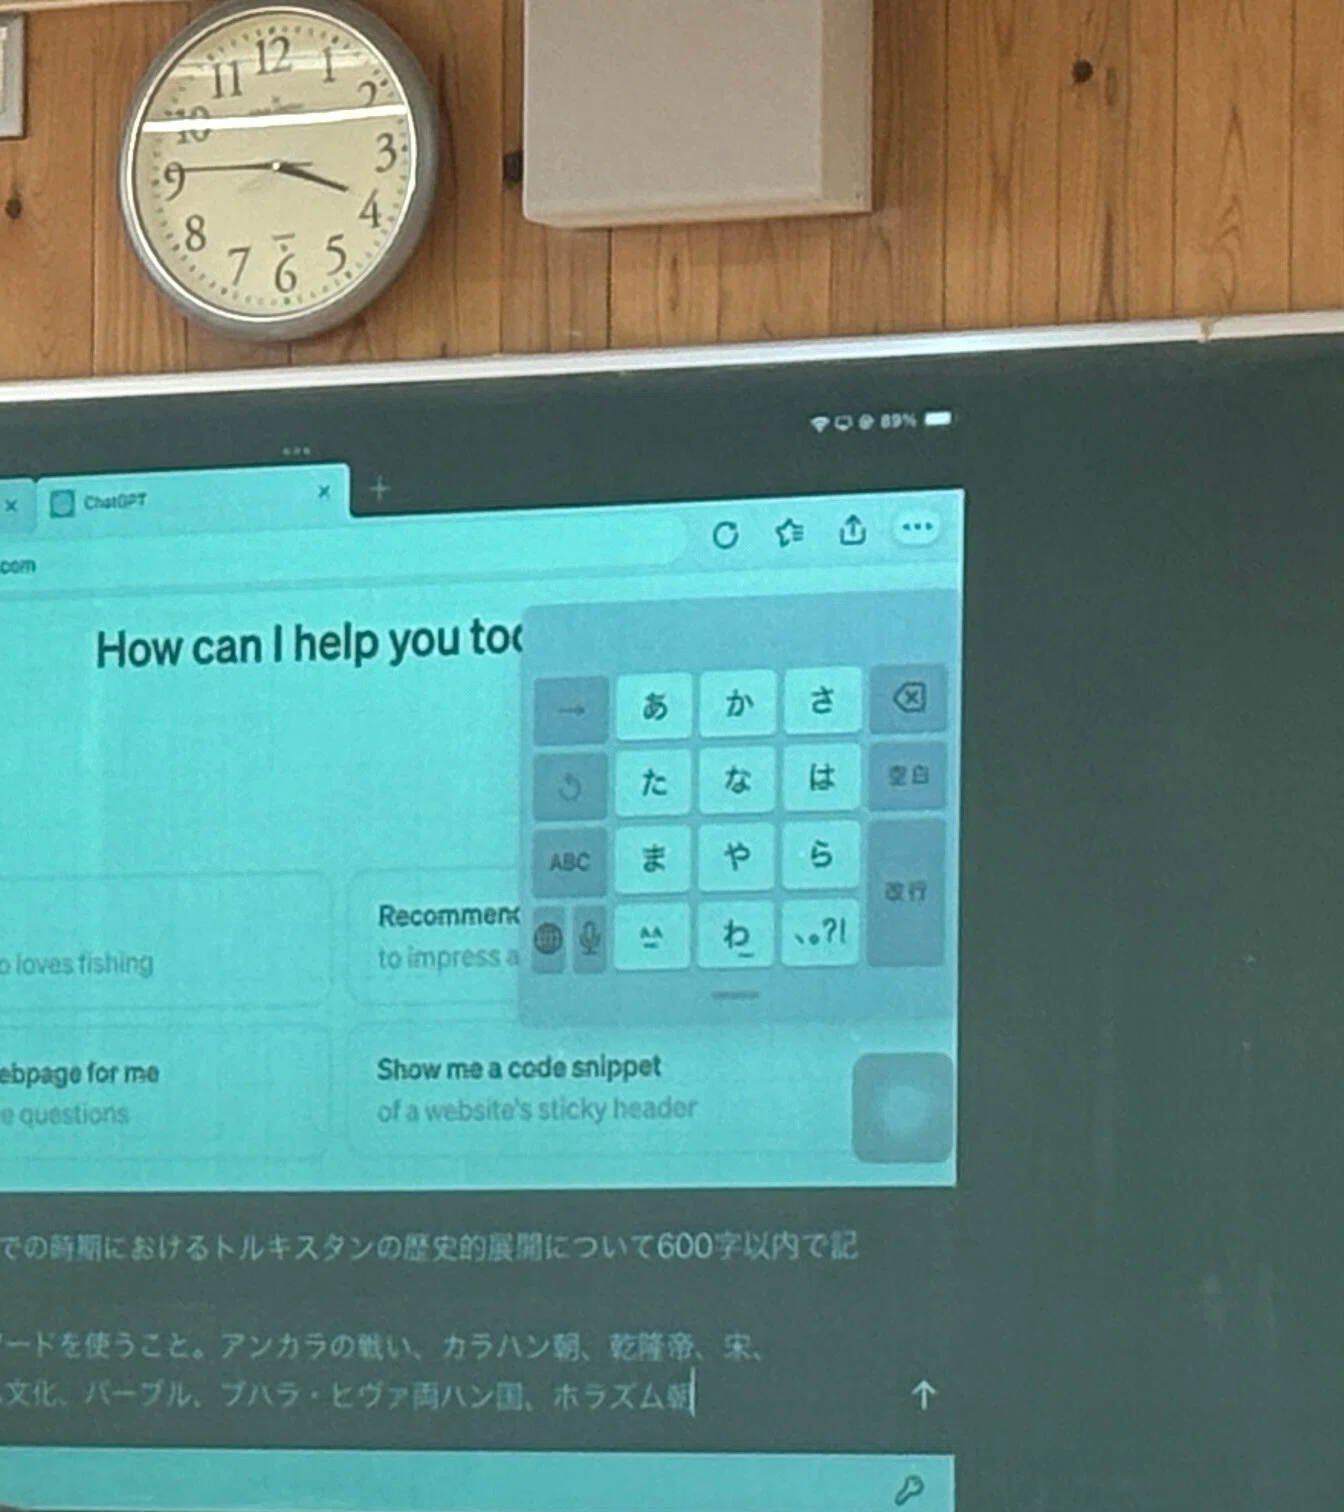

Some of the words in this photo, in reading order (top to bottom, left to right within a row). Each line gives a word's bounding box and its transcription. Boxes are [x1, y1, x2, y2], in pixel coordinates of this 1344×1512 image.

[255, 35, 293, 76] 12
[322, 46, 335, 83] 1
[212, 60, 243, 99] 11
[357, 80, 378, 107] 2
[176, 105, 211, 145] 10
[375, 132, 397, 173] 3
[164, 161, 186, 201] 9
[358, 188, 381, 229] 4
[185, 214, 206, 252] 8
[228, 247, 252, 286] 7
[274, 253, 297, 293] 6
[326, 233, 347, 276] 5
[880, 413, 917, 430] 89%
[84, 492, 147, 510] ChatGPT
[96, 629, 185, 668] How
[192, 632, 262, 665] can
[272, 623, 283, 663] I
[294, 621, 380, 668] help
[389, 624, 461, 667] you
[643, 691, 669, 721] あ
[725, 687, 754, 718] か
[810, 684, 836, 714] さ
[641, 767, 668, 797] た
[724, 764, 752, 793] な
[809, 762, 836, 791] は
[549, 851, 591, 873] ABC
[643, 844, 666, 873] ま
[724, 841, 752, 870] や
[810, 839, 833, 869] ら
[16, 951, 74, 976] loves
[78, 949, 154, 980] fishing
[379, 949, 402, 969] to
[407, 946, 501, 974] impress
[86, 1059, 119, 1084] for
[123, 1064, 161, 1084] me
[377, 1057, 442, 1082] Show
[447, 1060, 484, 1081] me
[487, 1061, 503, 1080] a
[508, 1055, 568, 1079] code
[571, 1053, 662, 1083] snippet
[18, 1102, 130, 1130] questions
[377, 1099, 402, 1123] of
[405, 1105, 420, 1123] a
[424, 1096, 532, 1122] website's
[538, 1096, 607, 1125] sticky
[612, 1095, 698, 1121] header
